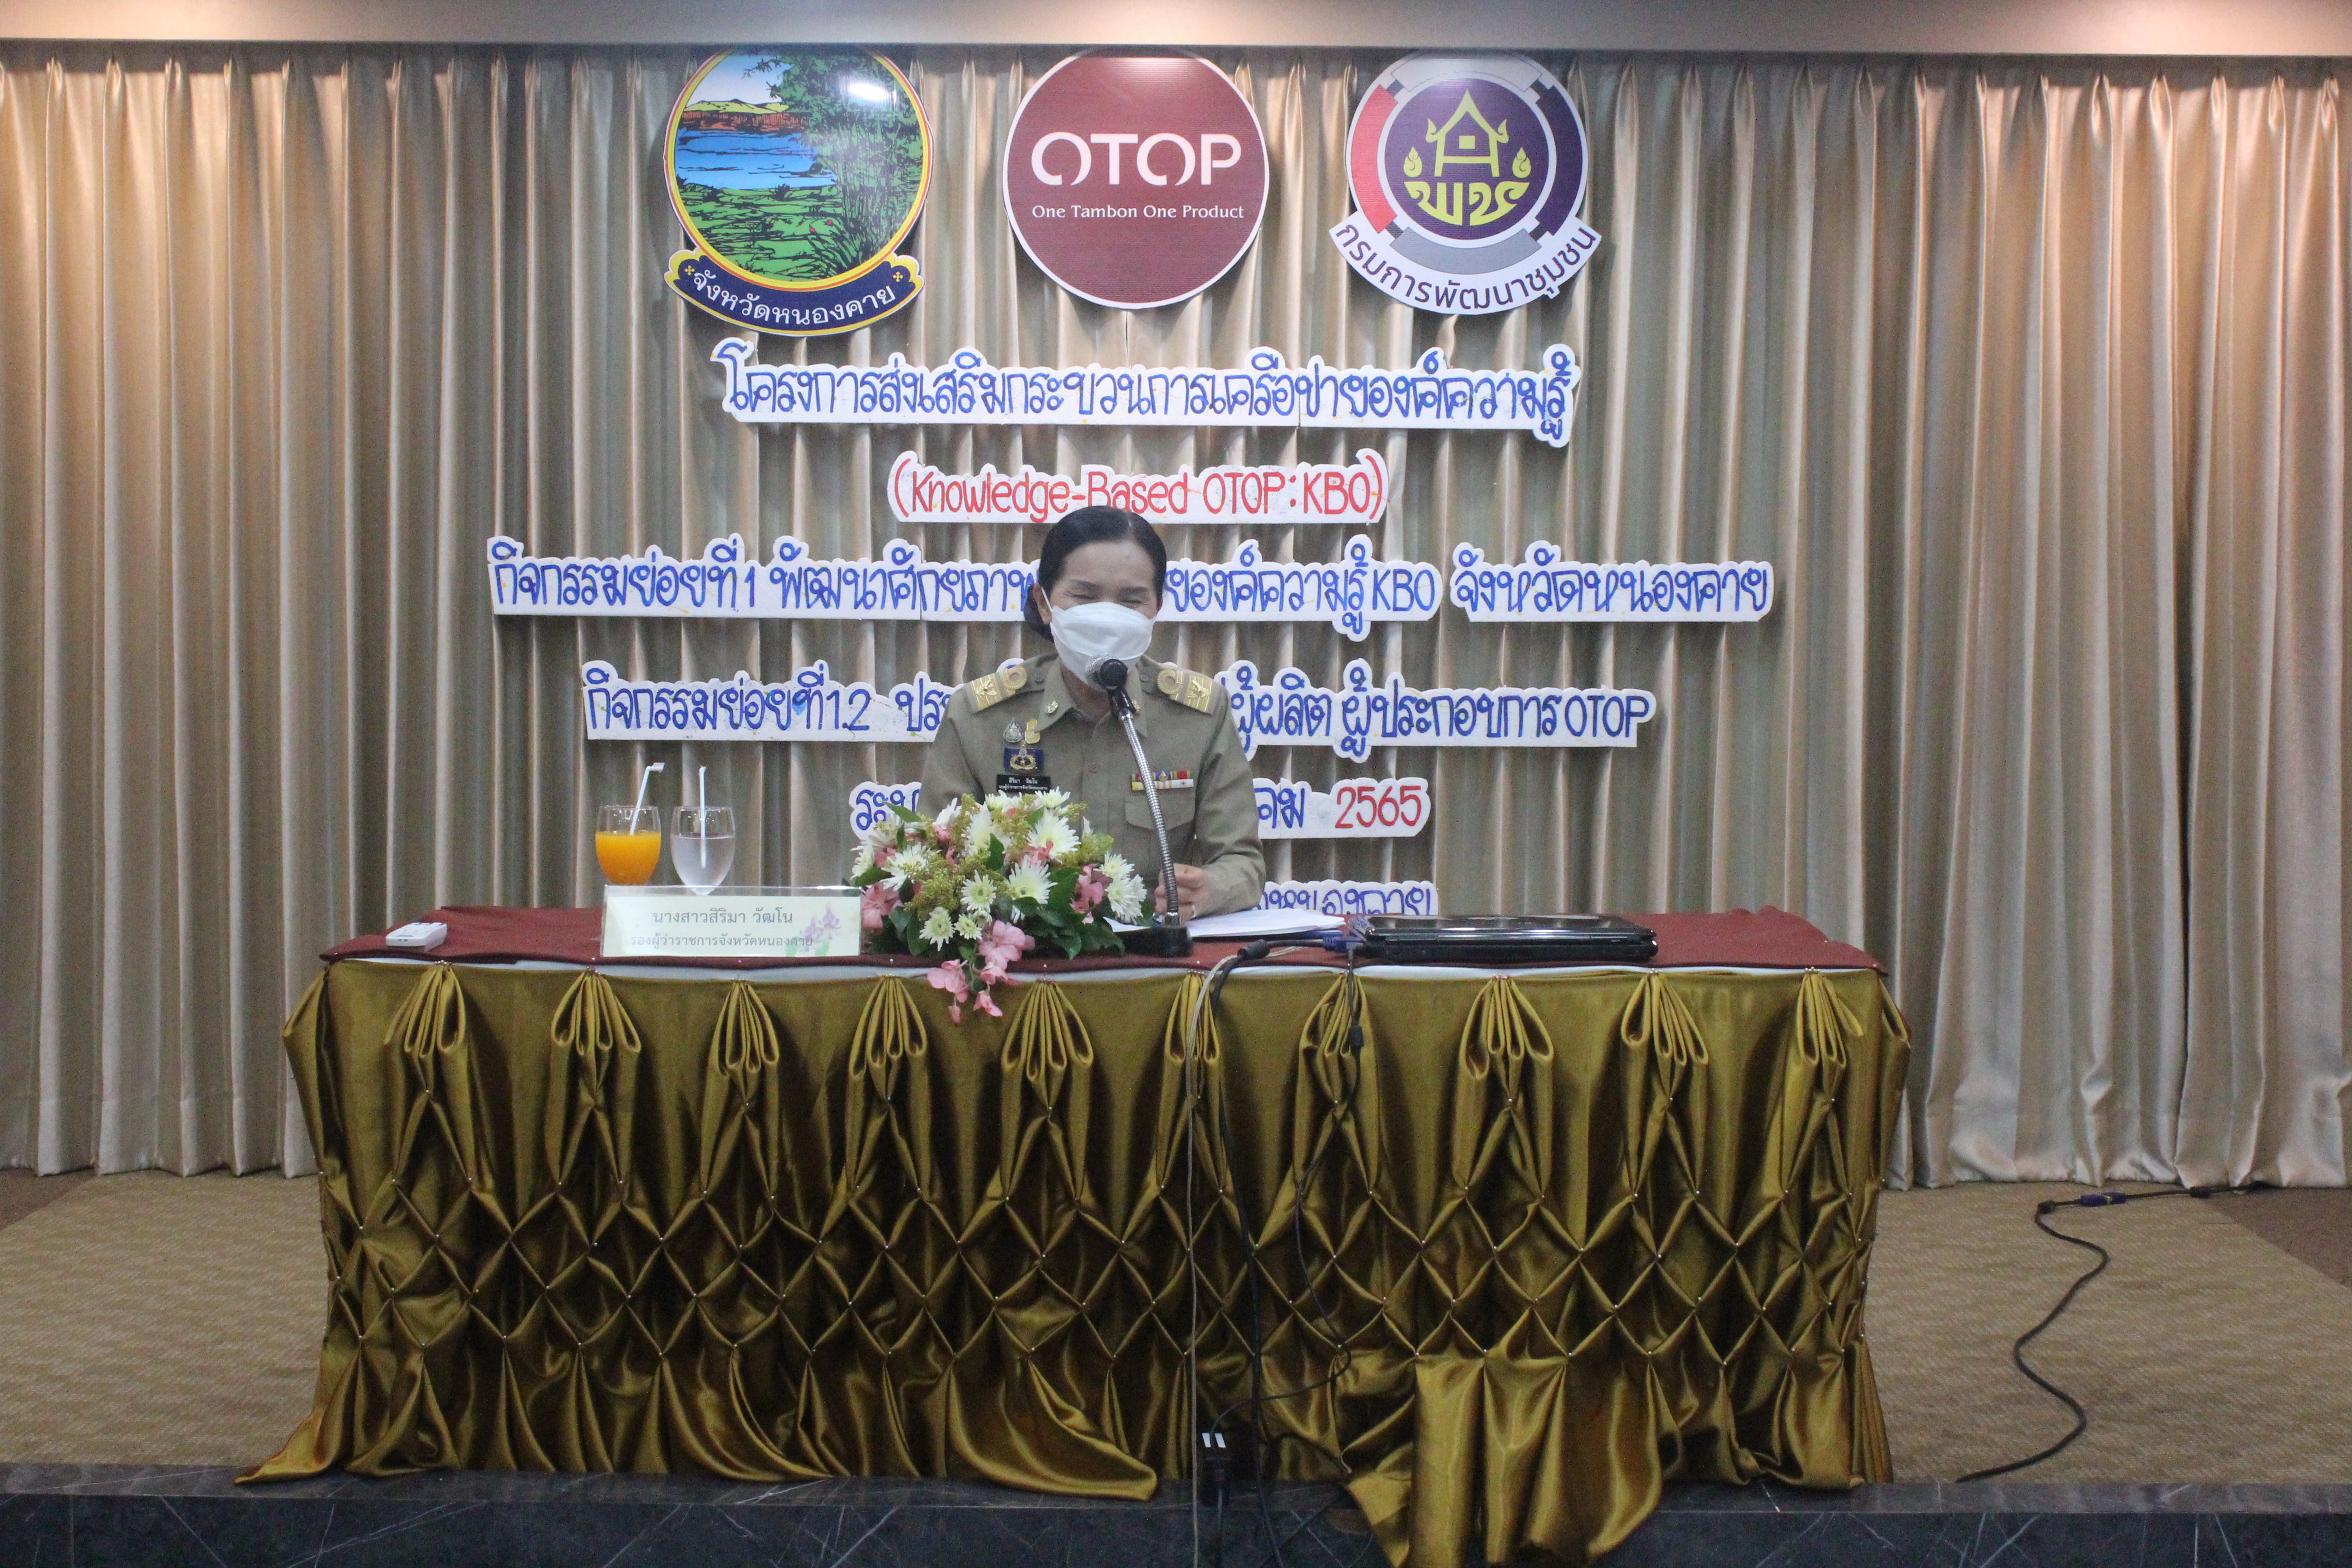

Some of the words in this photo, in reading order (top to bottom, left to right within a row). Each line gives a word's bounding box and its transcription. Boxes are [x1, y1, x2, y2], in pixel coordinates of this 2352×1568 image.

[1031, 132, 1242, 186] OTOP
[1032, 205, 1065, 218] One
[1071, 205, 1137, 218] Tambon
[1143, 205, 1176, 218] One
[1182, 205, 1244, 218] Product
[1335, 223, 1597, 309] กรมการพัฒนาชุมชน
[693, 269, 896, 325] จังหวัดหนองคาย
[1455, 548, 1767, 612] จังหวัดหนองคาย
[1335, 785, 1422, 829] 2565
[653, 907, 745, 923] นางสาวสิริมา
[753, 907, 793, 923] วัฒโน
[631, 932, 813, 950] รองผู้ว่าราชการจังหวัดหนองคาย
